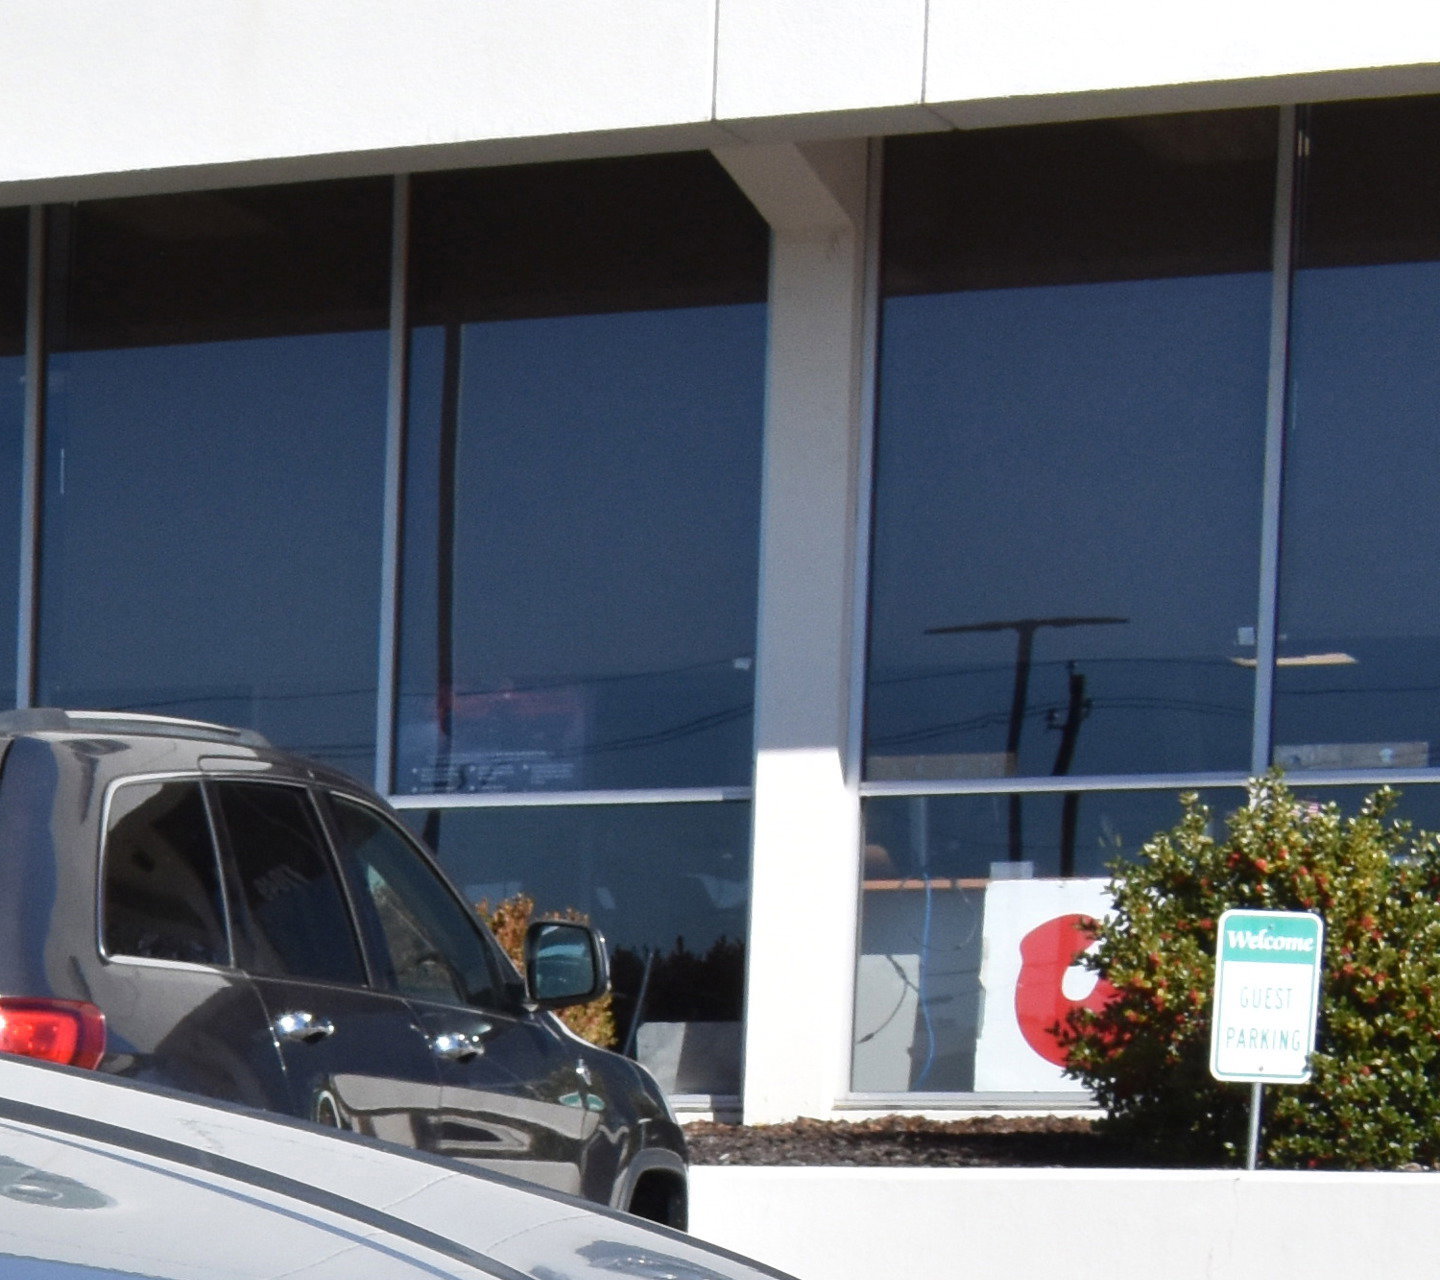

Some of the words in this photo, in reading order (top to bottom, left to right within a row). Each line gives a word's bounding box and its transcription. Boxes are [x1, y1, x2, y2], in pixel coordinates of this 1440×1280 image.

[1226, 929, 1314, 952] Welcome
[1240, 986, 1293, 1009] GUEST
[1225, 1027, 1301, 1051] PARKING
